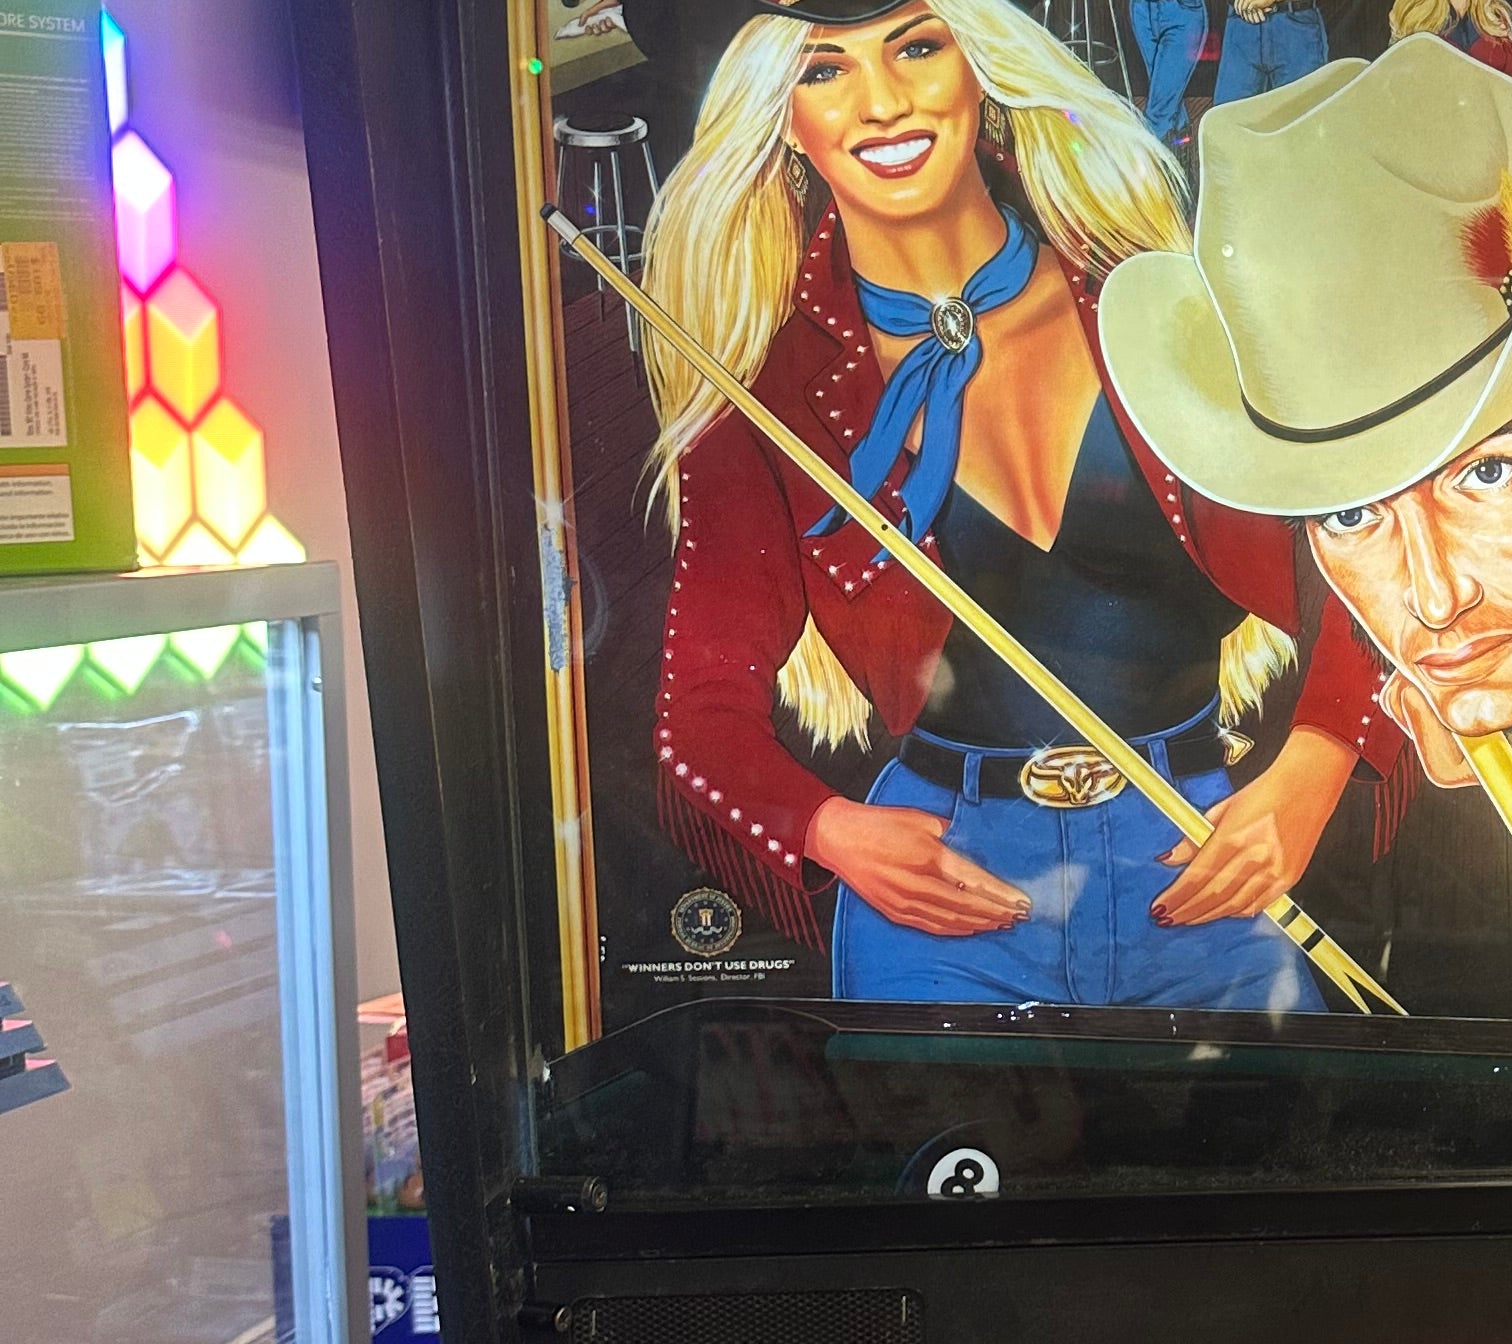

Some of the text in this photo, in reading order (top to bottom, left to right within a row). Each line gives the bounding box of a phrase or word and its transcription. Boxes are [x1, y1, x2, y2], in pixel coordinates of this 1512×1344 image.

[29, 15, 86, 33] SYSTEM
[684, 960, 722, 972] DON'T
[725, 960, 747, 971] USE
